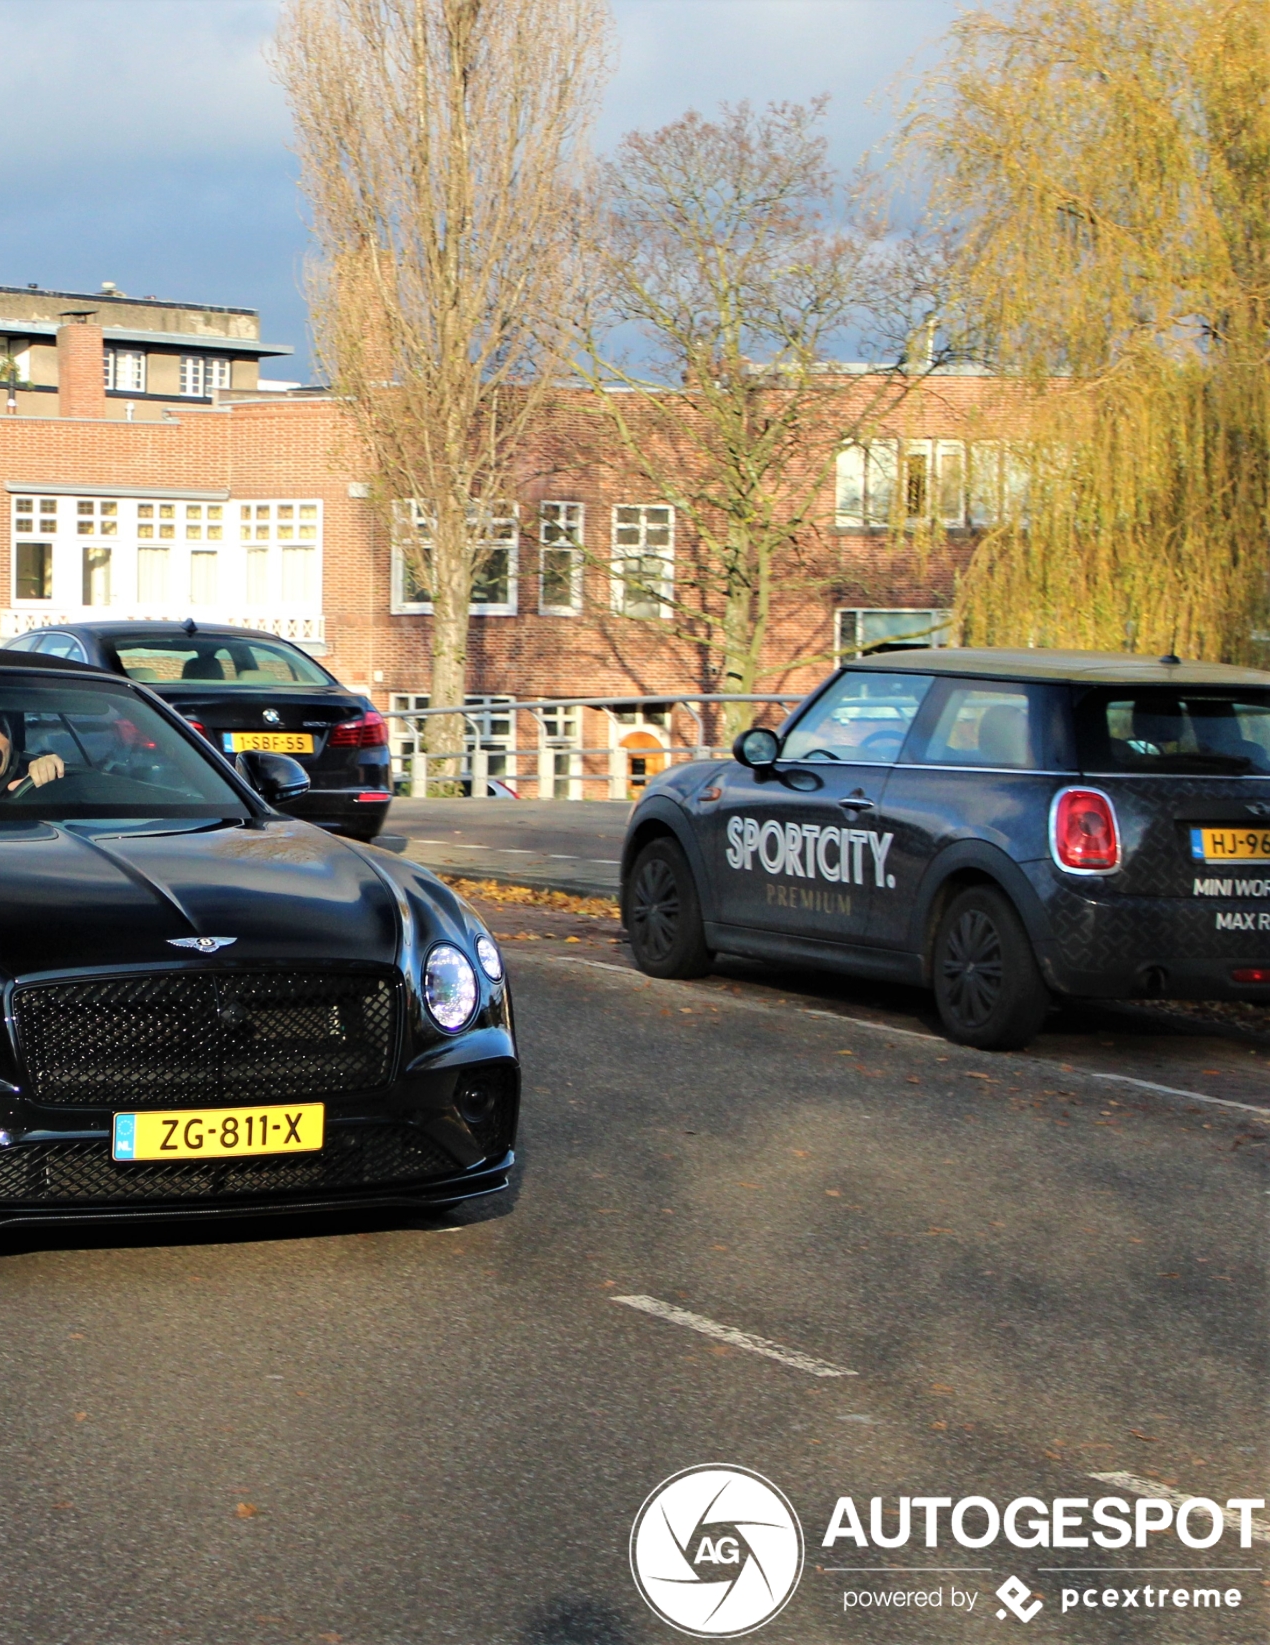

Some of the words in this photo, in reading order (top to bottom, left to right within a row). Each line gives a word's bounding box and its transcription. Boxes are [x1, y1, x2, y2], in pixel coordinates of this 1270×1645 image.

[239, 737, 305, 750] 1-SBF-55
[1193, 878, 1233, 896] MINI
[765, 883, 852, 916] PREMIUM
[1215, 912, 1255, 930] MAX
[159, 1113, 303, 1150] ZG-811-X
[117, 1140, 132, 1151] NL
